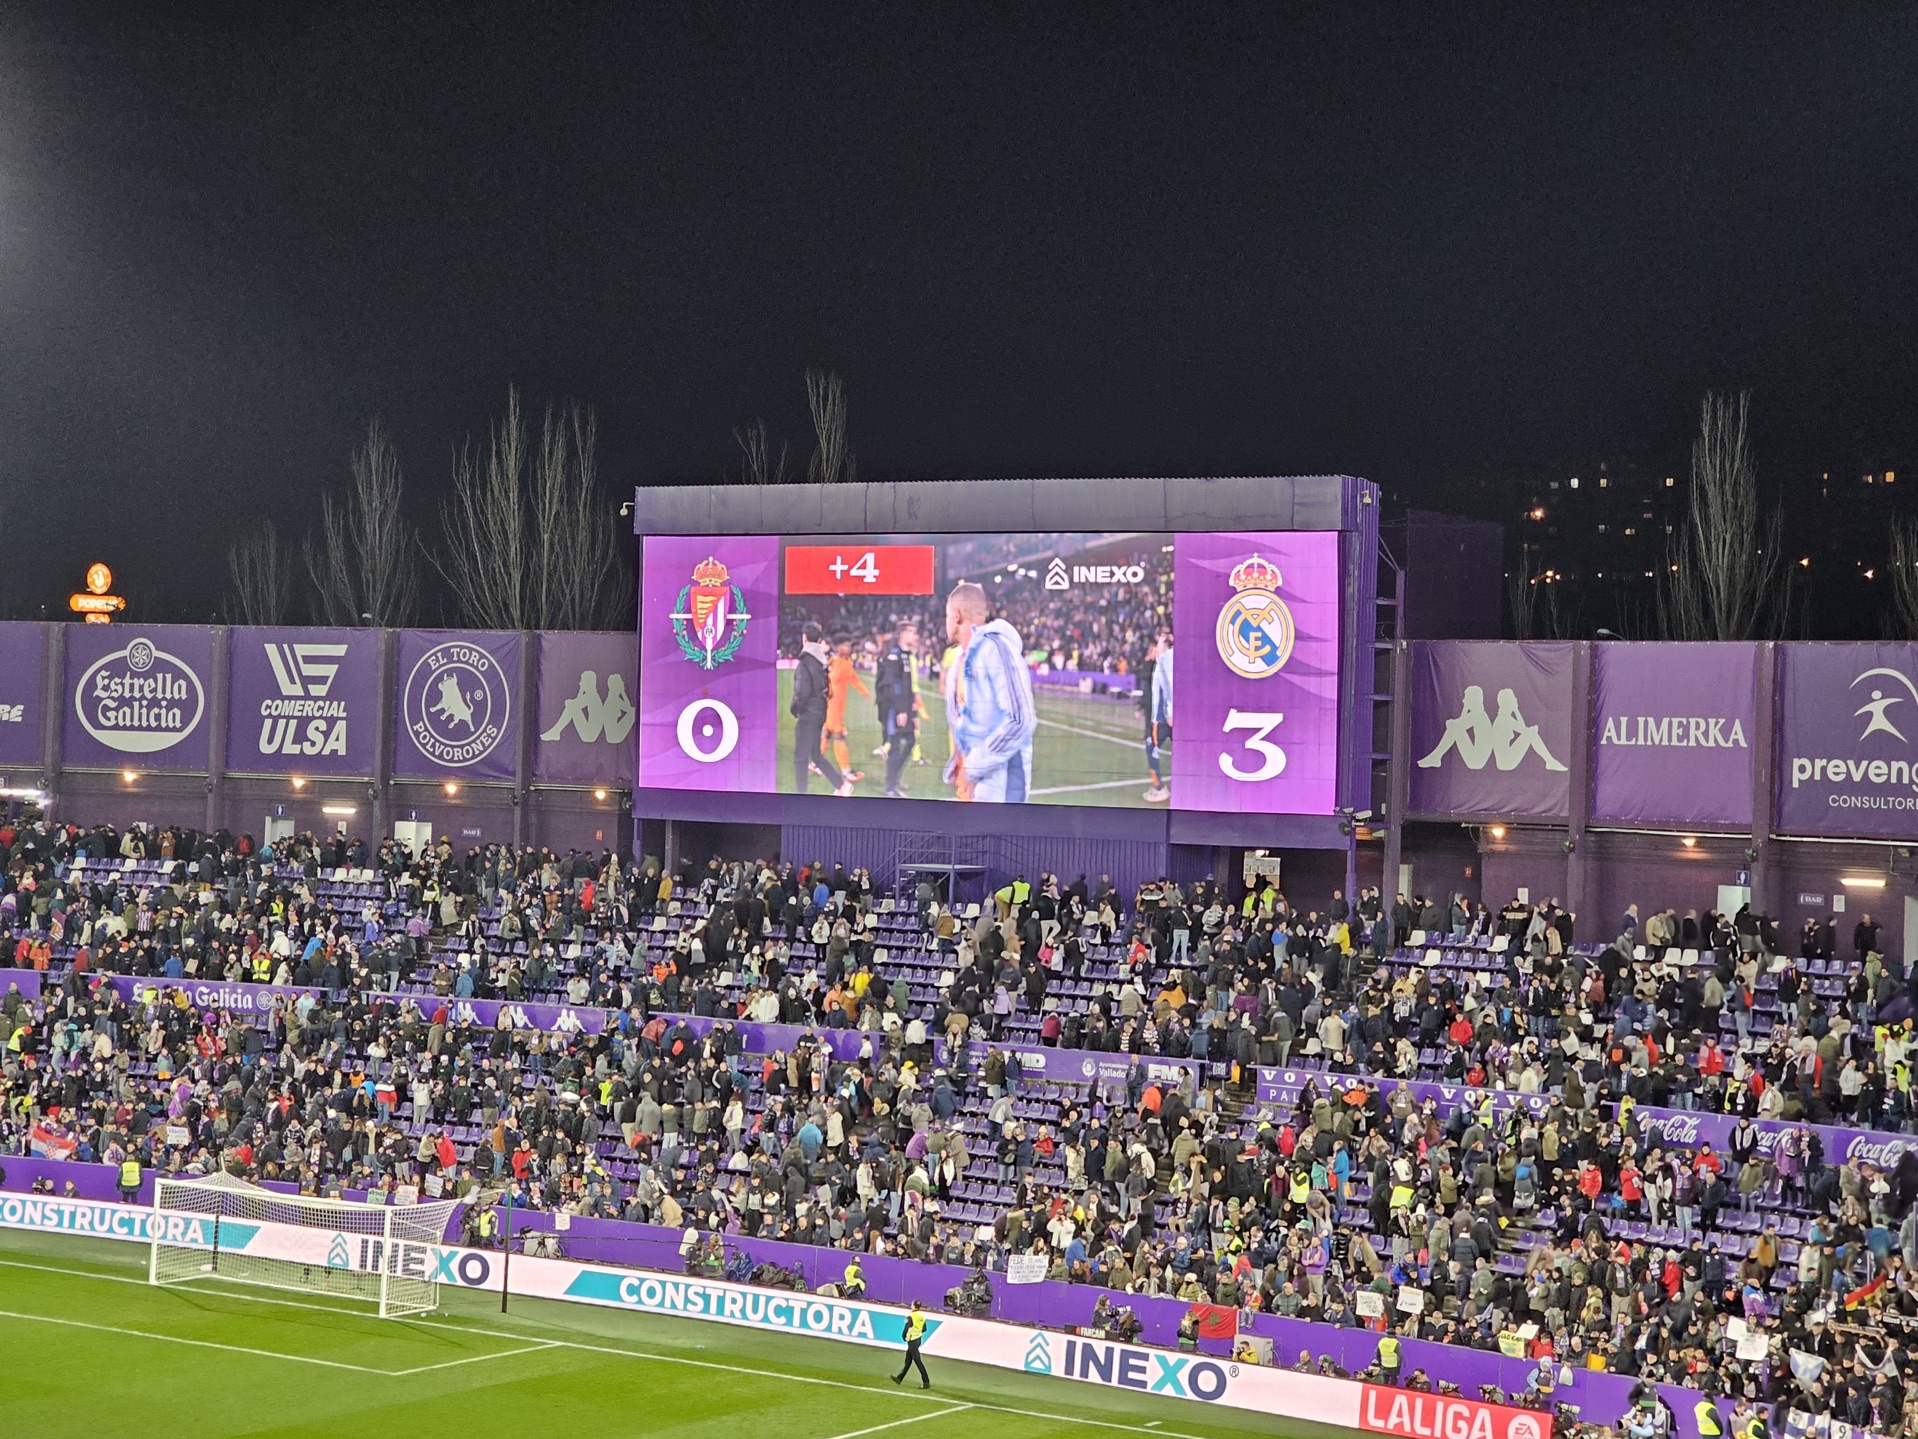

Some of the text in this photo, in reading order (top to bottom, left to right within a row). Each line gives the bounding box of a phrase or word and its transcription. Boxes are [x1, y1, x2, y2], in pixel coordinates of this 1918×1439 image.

[828, 552, 880, 583] +4
[1073, 566, 1145, 584] INEXO
[427, 647, 489, 671] EL TORO
[93, 670, 188, 700] Estrella
[98, 699, 182, 728] Galicia
[260, 699, 347, 718] COMERCIAL
[259, 718, 347, 756] ULSA
[413, 720, 498, 761] POLVORONES
[676, 698, 739, 763] 0
[1218, 707, 1287, 782] 3
[1600, 716, 1748, 748] ALIMERKA
[0, 1198, 205, 1244] ONSTRUCTORA
[359, 1238, 490, 1286] INEXO
[619, 1276, 875, 1340] CONSTRUCTORA
[1064, 1339, 1227, 1401] INEXO
[1366, 1389, 1494, 1439] LALIGA
[1515, 1422, 1534, 1437] EA
